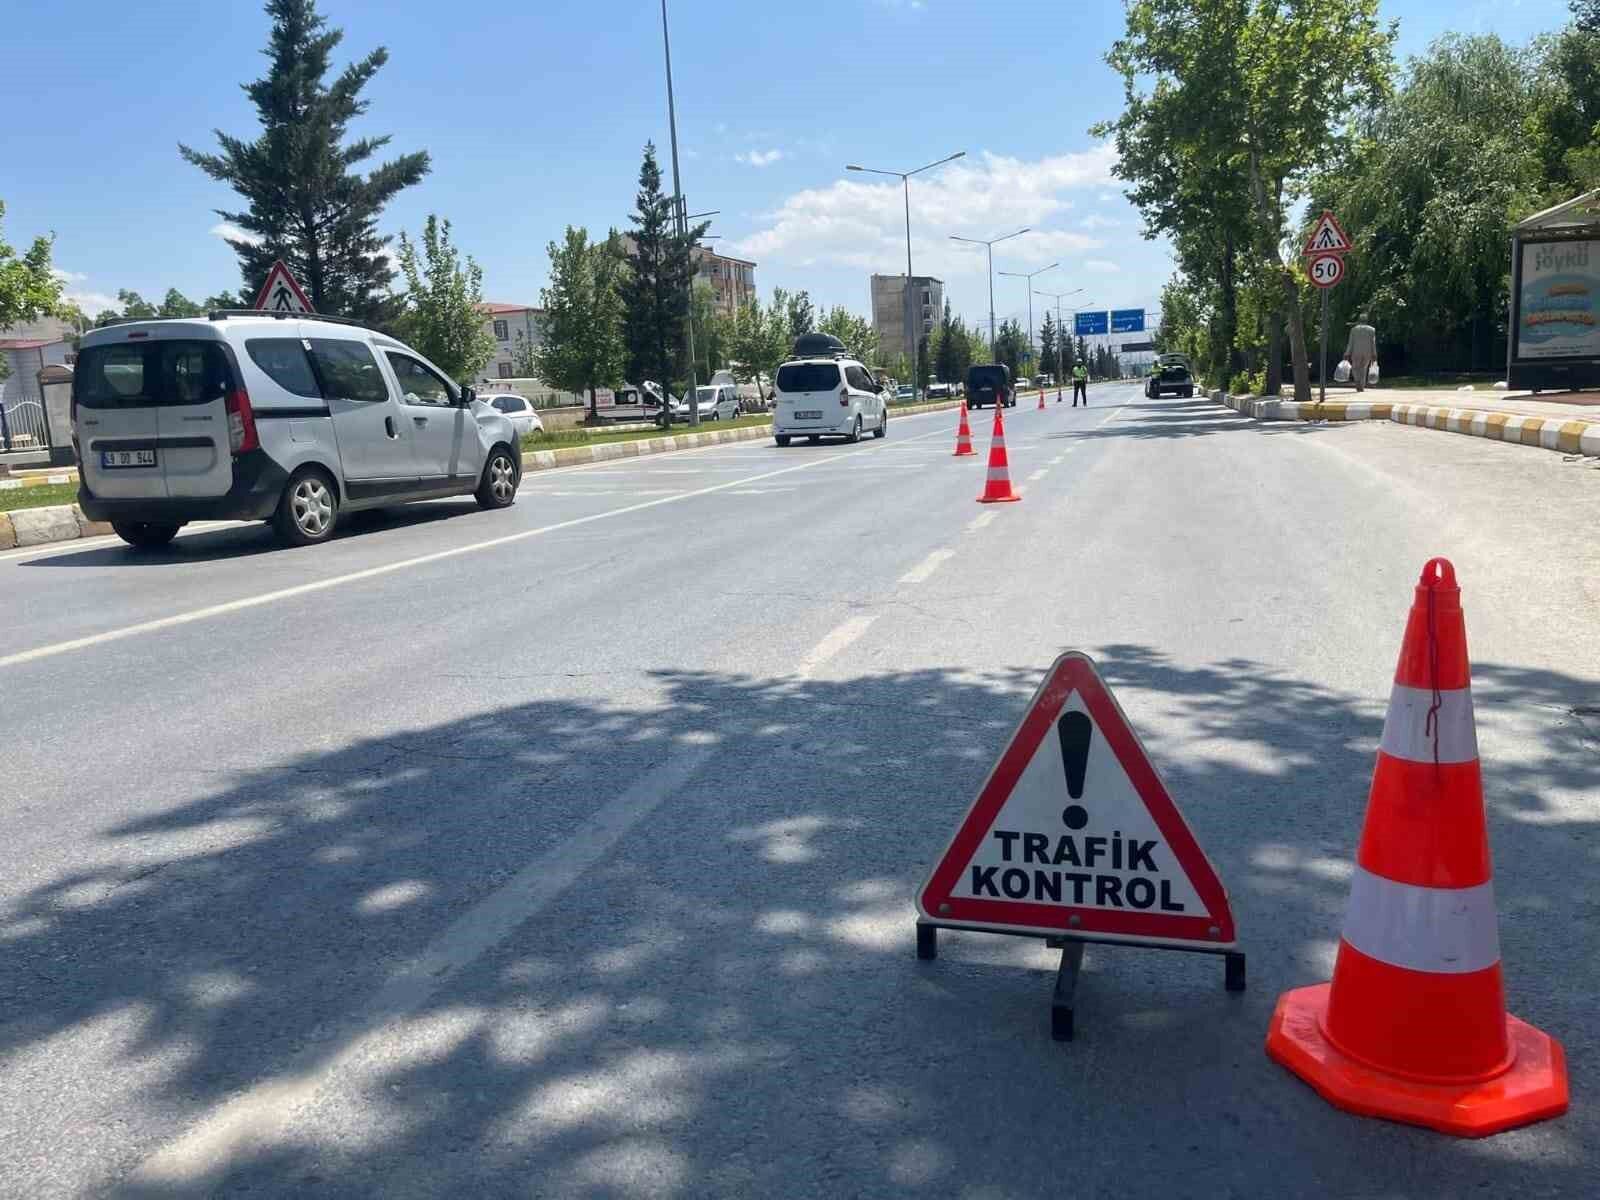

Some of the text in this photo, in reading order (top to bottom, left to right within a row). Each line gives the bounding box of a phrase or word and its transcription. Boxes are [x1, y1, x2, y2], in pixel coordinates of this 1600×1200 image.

[1315, 262, 1337, 278] 50
[994, 831, 1159, 872] TRAFİK
[972, 866, 1184, 911] KONTROL
